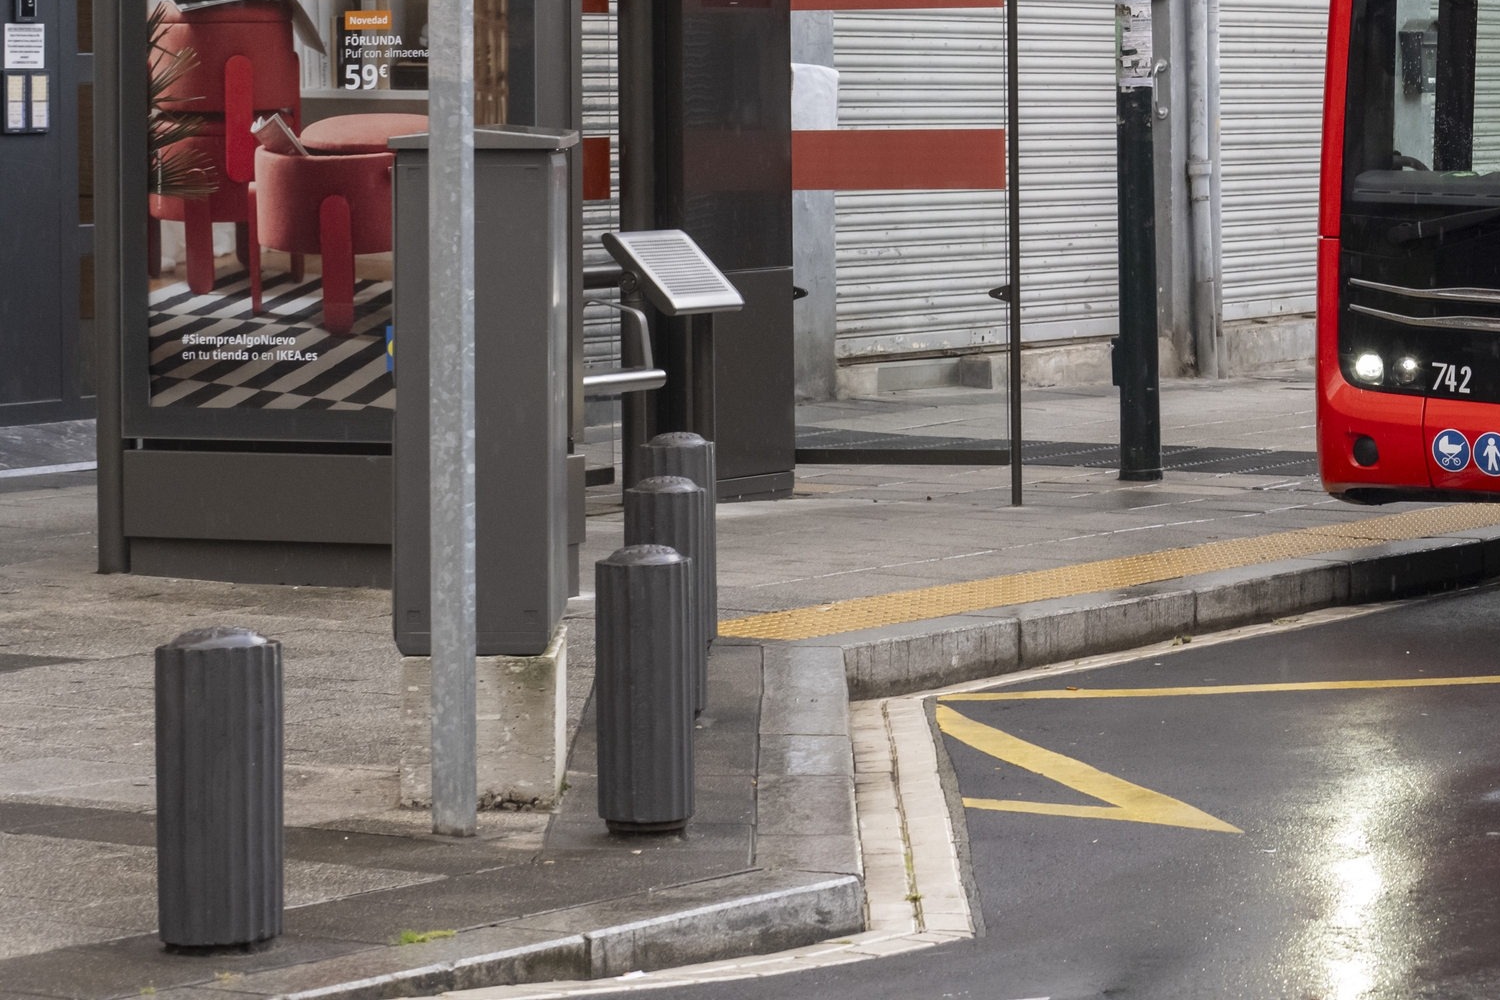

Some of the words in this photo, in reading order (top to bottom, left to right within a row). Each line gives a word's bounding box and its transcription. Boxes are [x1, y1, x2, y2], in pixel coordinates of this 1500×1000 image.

[349, 16, 388, 25] Novedad
[345, 34, 402, 46] FÖRLUNDA
[345, 48, 363, 58] Puf
[364, 50, 382, 58] con
[182, 334, 296, 347] #SiempreAlgoNuevo
[182, 351, 196, 360] en
[198, 350, 210, 360] tu
[213, 349, 248, 360] tienda
[251, 352, 259, 360] o
[261, 351, 274, 360] en
[276, 350, 318, 361] IKEA.es
[1431, 361, 1472, 394] 742
